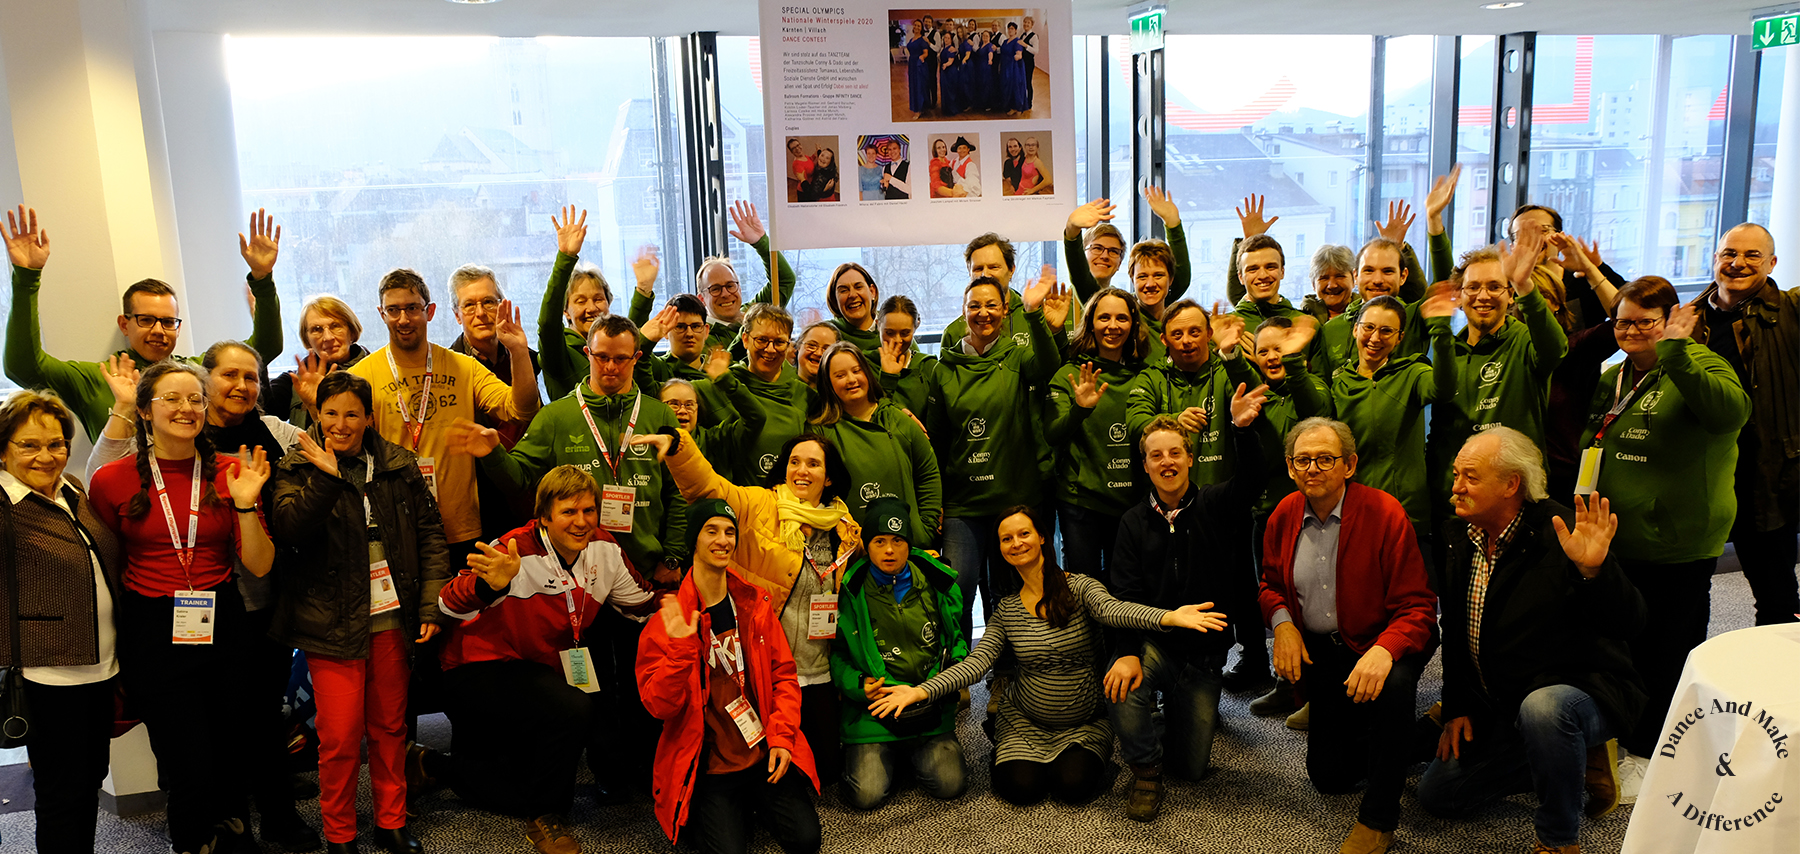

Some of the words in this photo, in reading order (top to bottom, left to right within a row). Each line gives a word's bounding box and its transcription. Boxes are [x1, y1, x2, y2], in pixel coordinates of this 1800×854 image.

[816, 17, 855, 25] Winterspiele
[381, 377, 409, 395] TOM
[439, 394, 457, 407] 62
[1472, 422, 1502, 431] Canon
[564, 445, 590, 453] erima
[1615, 451, 1647, 462] Canon
[633, 473, 652, 482] Conny
